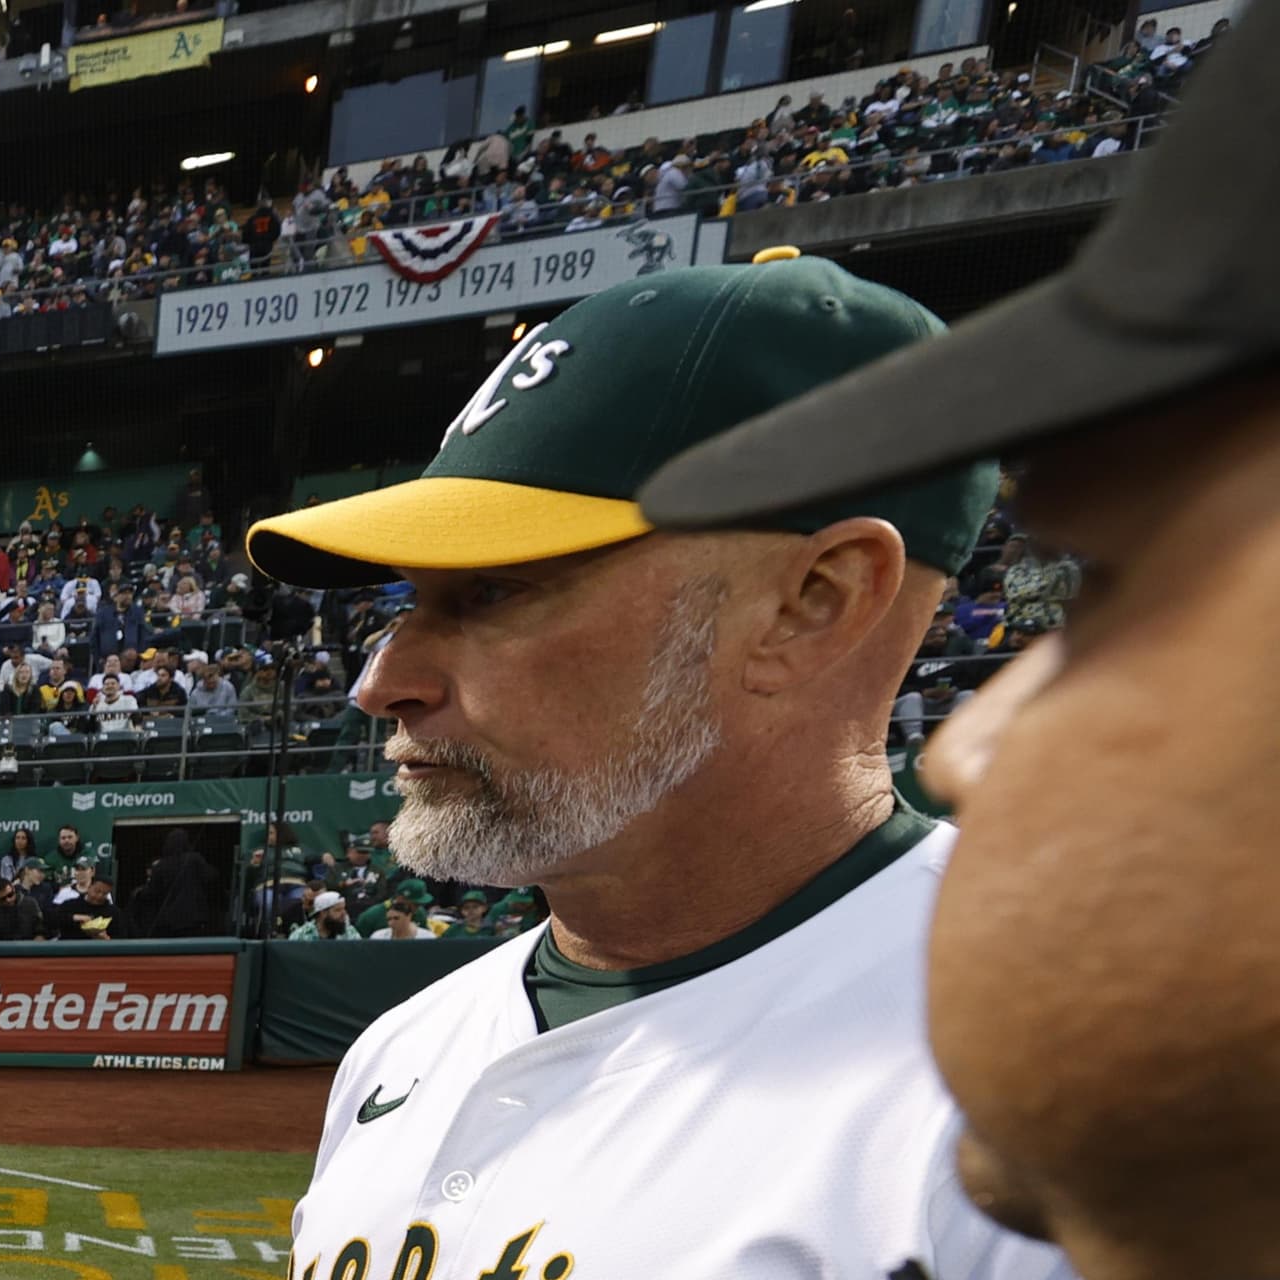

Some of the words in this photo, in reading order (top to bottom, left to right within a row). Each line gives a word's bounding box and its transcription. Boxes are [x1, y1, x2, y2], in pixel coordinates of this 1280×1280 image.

[176, 302, 229, 335] 1929
[243, 293, 298, 326] 1930
[313, 282, 371, 318] 1972
[385, 278, 441, 308] 1973
[458, 261, 516, 298] 1974
[533, 248, 596, 286] 1989
[101, 792, 175, 808] Chevron
[93, 1055, 225, 1071] ATHLETICS.COM
